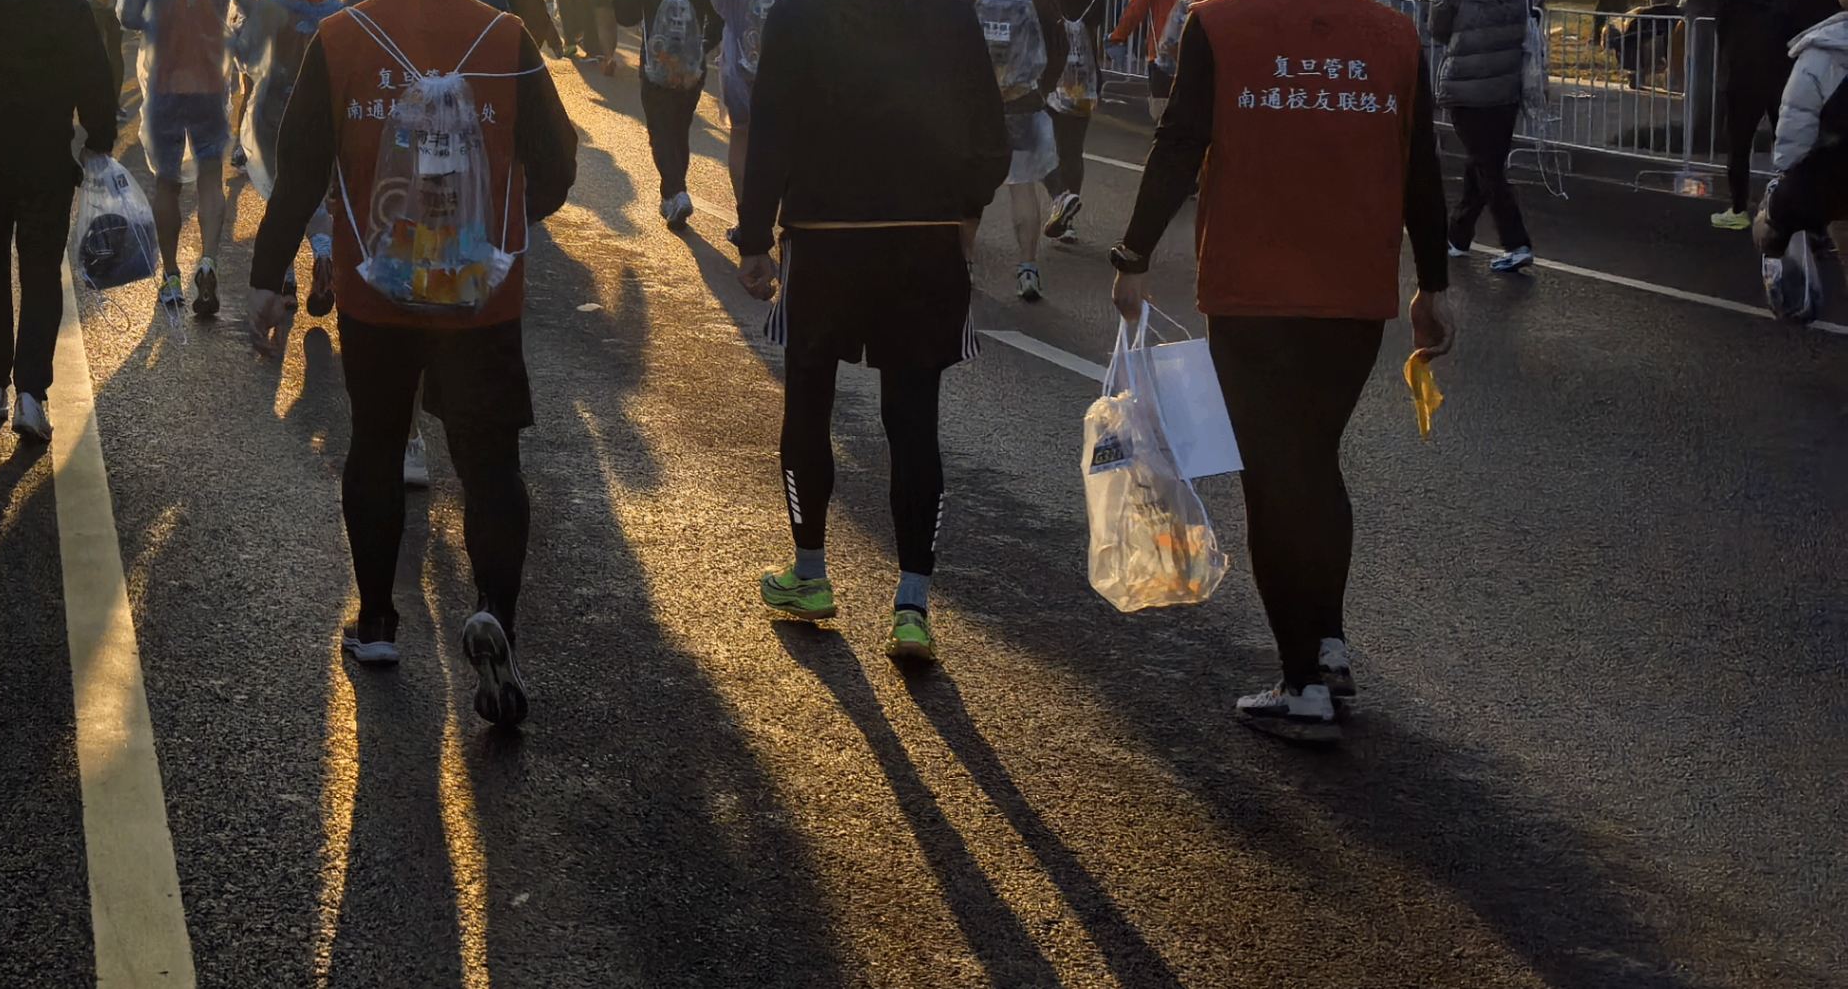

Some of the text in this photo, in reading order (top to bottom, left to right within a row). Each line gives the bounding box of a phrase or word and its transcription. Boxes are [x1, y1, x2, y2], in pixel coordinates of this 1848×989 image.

[1273, 55, 1368, 80] 复旦管院
[1237, 87, 1398, 115] 南通校友联络处
